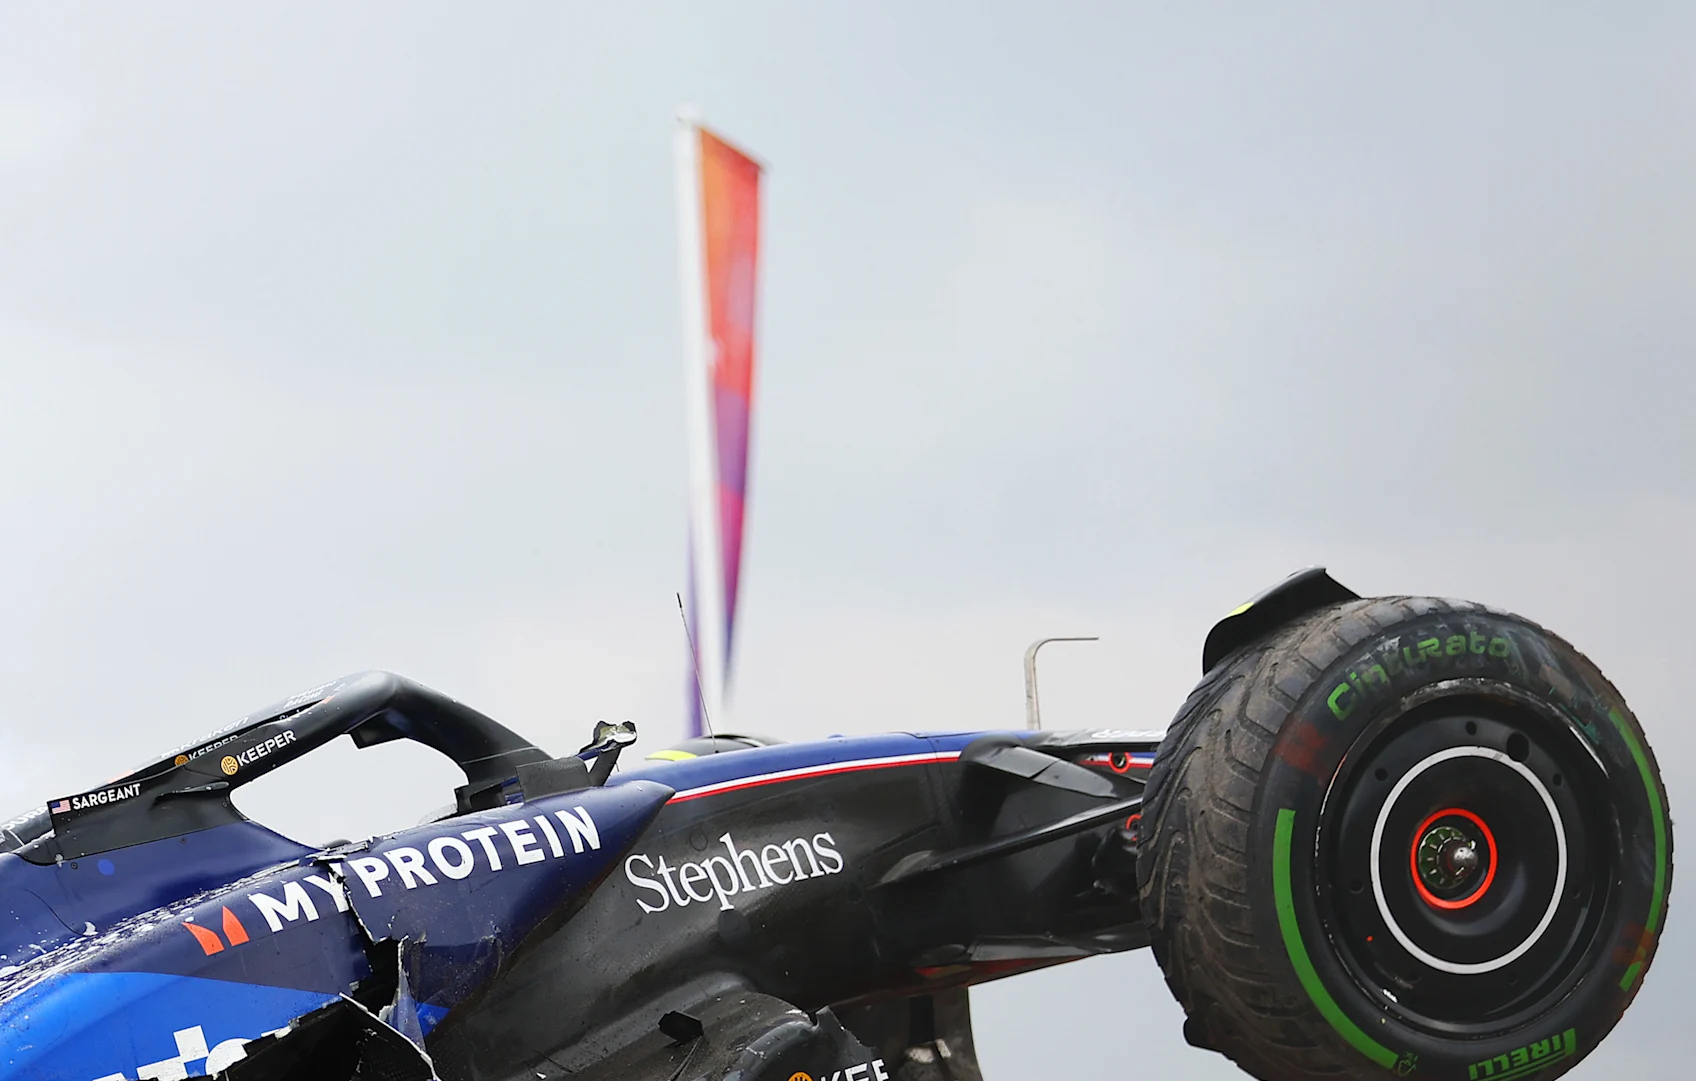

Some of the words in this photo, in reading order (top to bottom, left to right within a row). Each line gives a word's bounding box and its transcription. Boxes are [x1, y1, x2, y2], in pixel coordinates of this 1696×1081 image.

[1327, 630, 1510, 721] Cinturato
[237, 730, 297, 767] KEEPER
[72, 783, 141, 810] SARGEANT
[247, 805, 602, 933] MYPROTEIN
[624, 832, 843, 914] Stephens
